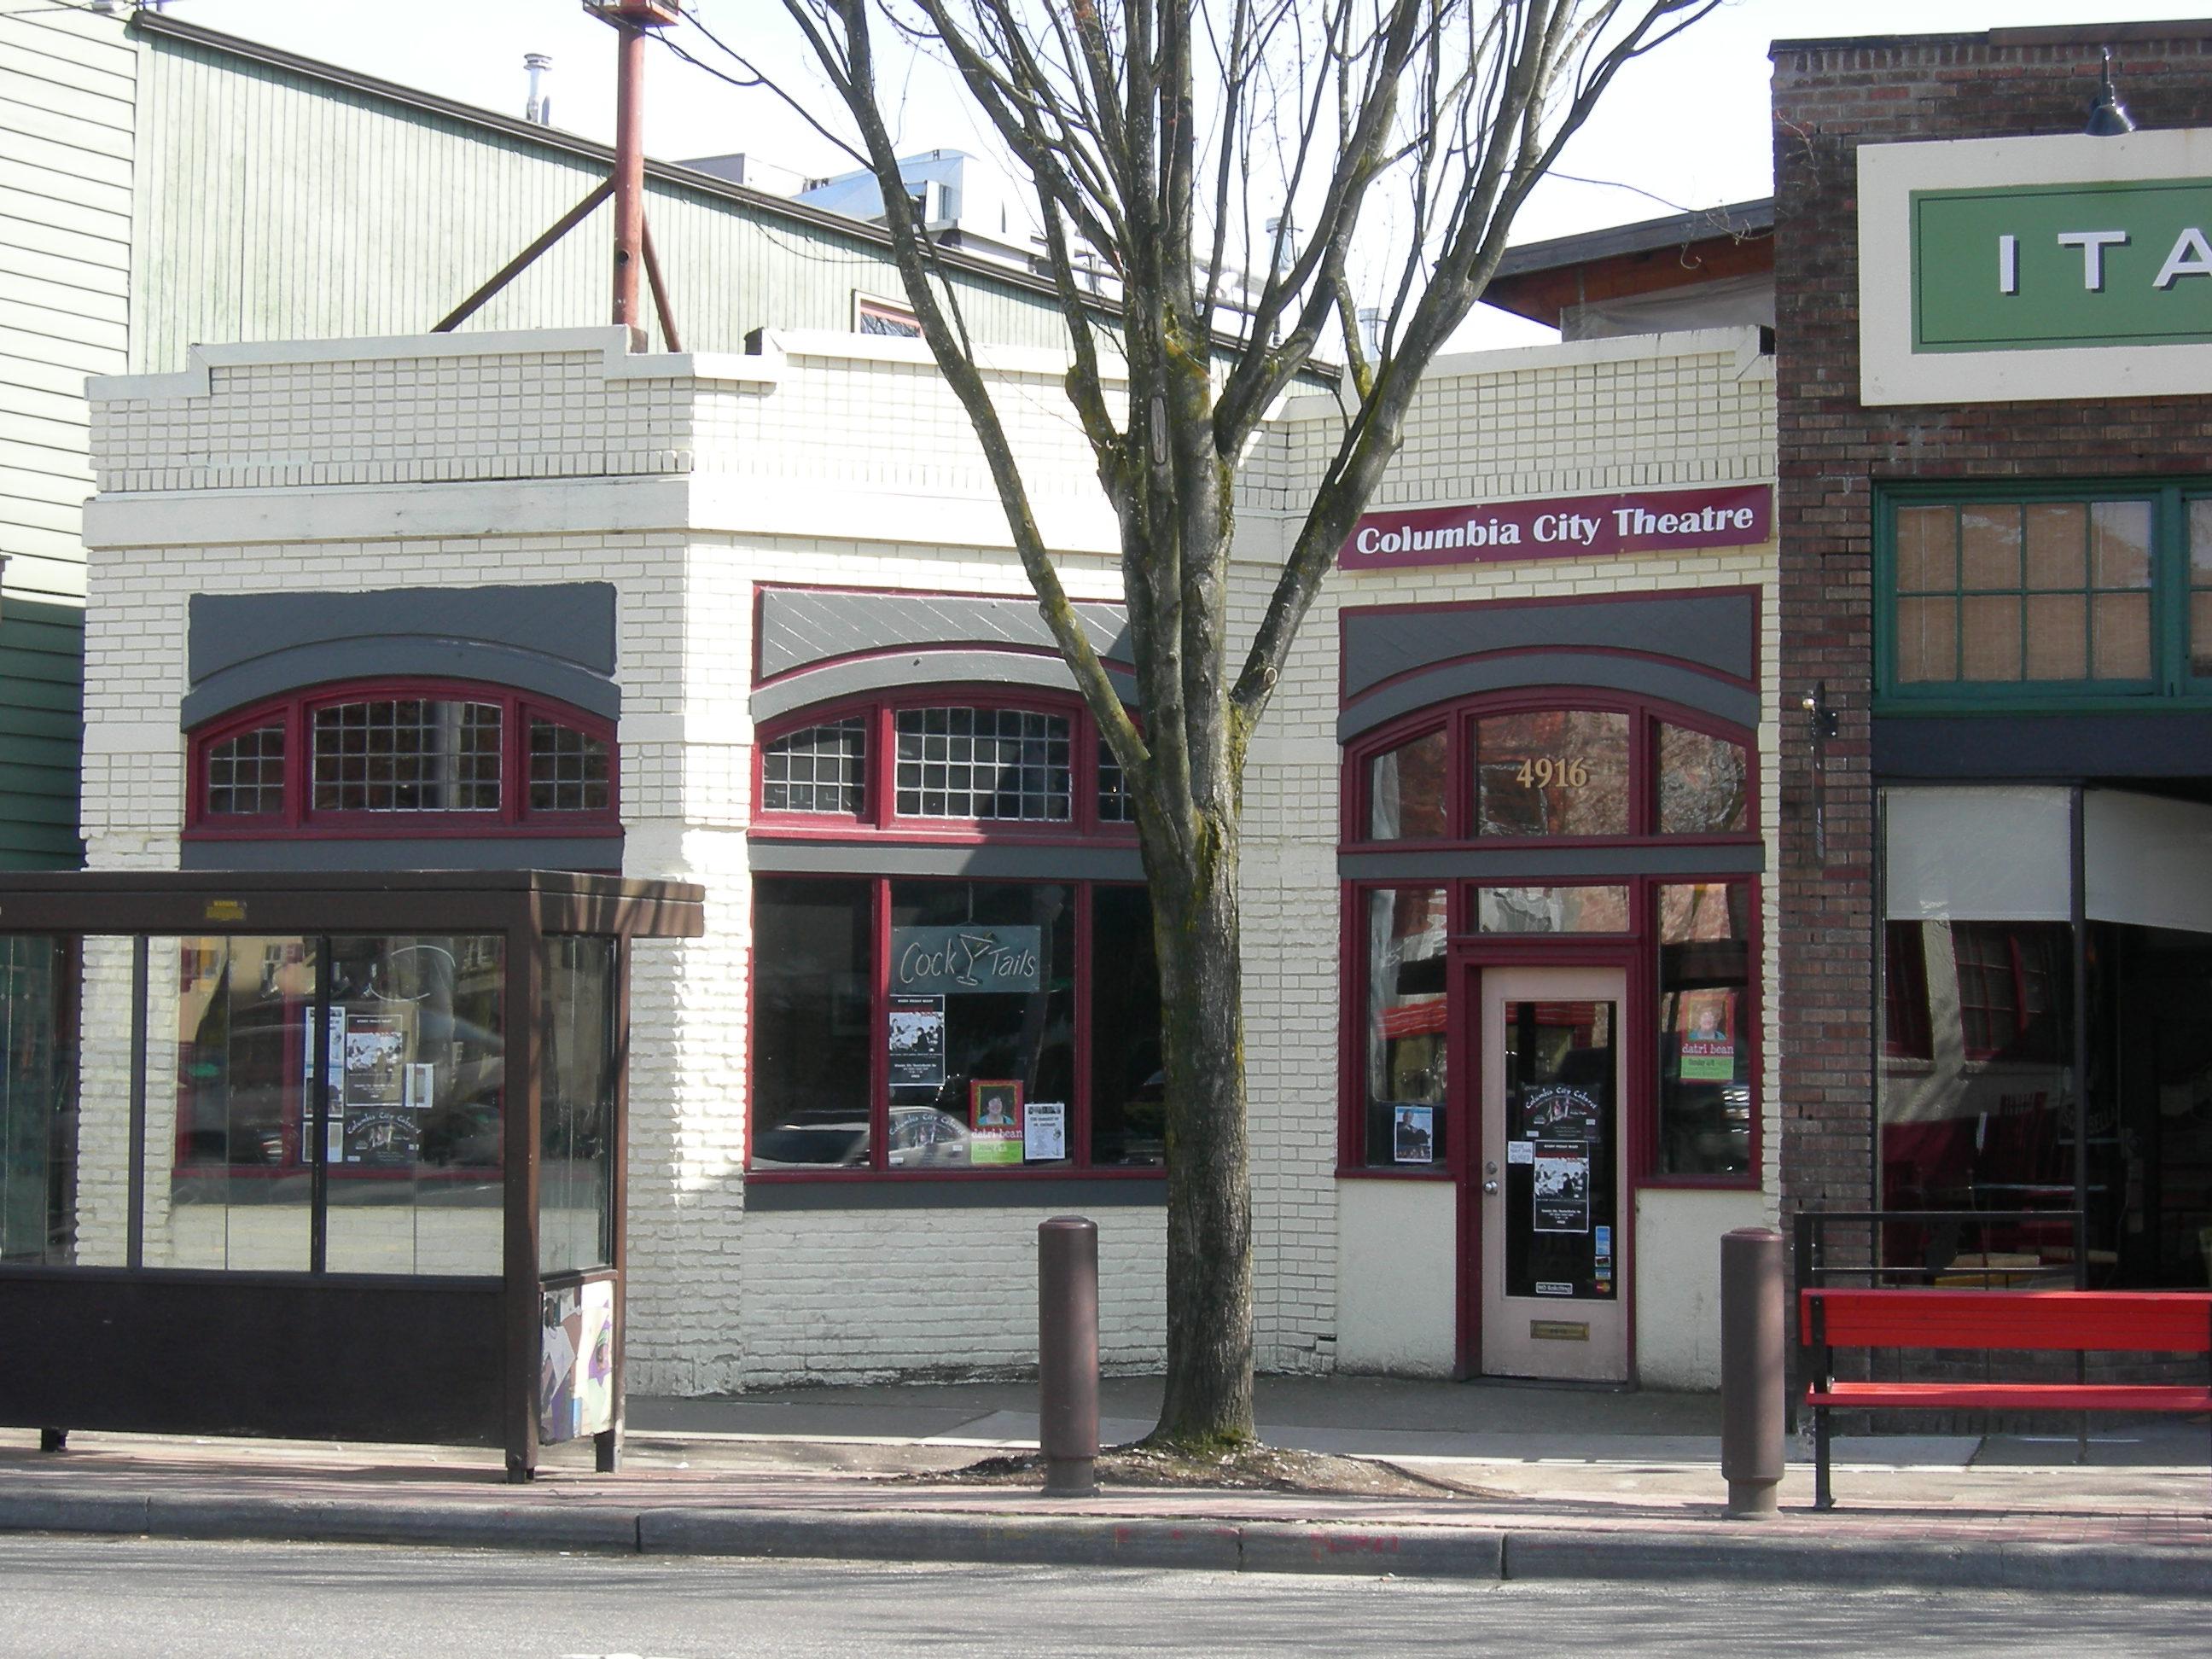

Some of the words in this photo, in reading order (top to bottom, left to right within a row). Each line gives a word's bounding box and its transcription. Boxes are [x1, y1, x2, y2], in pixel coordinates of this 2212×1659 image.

[1356, 518, 1521, 554] Columbia
[1534, 513, 1602, 546] City
[1612, 506, 1754, 537] Theatre
[1516, 756, 1587, 789] 4916
[988, 946, 1036, 977] Tails
[1681, 1043, 1708, 1054] datri
[1709, 1043, 1735, 1054] bean
[971, 1128, 998, 1138] datri
[999, 1128, 1023, 1138] bean
